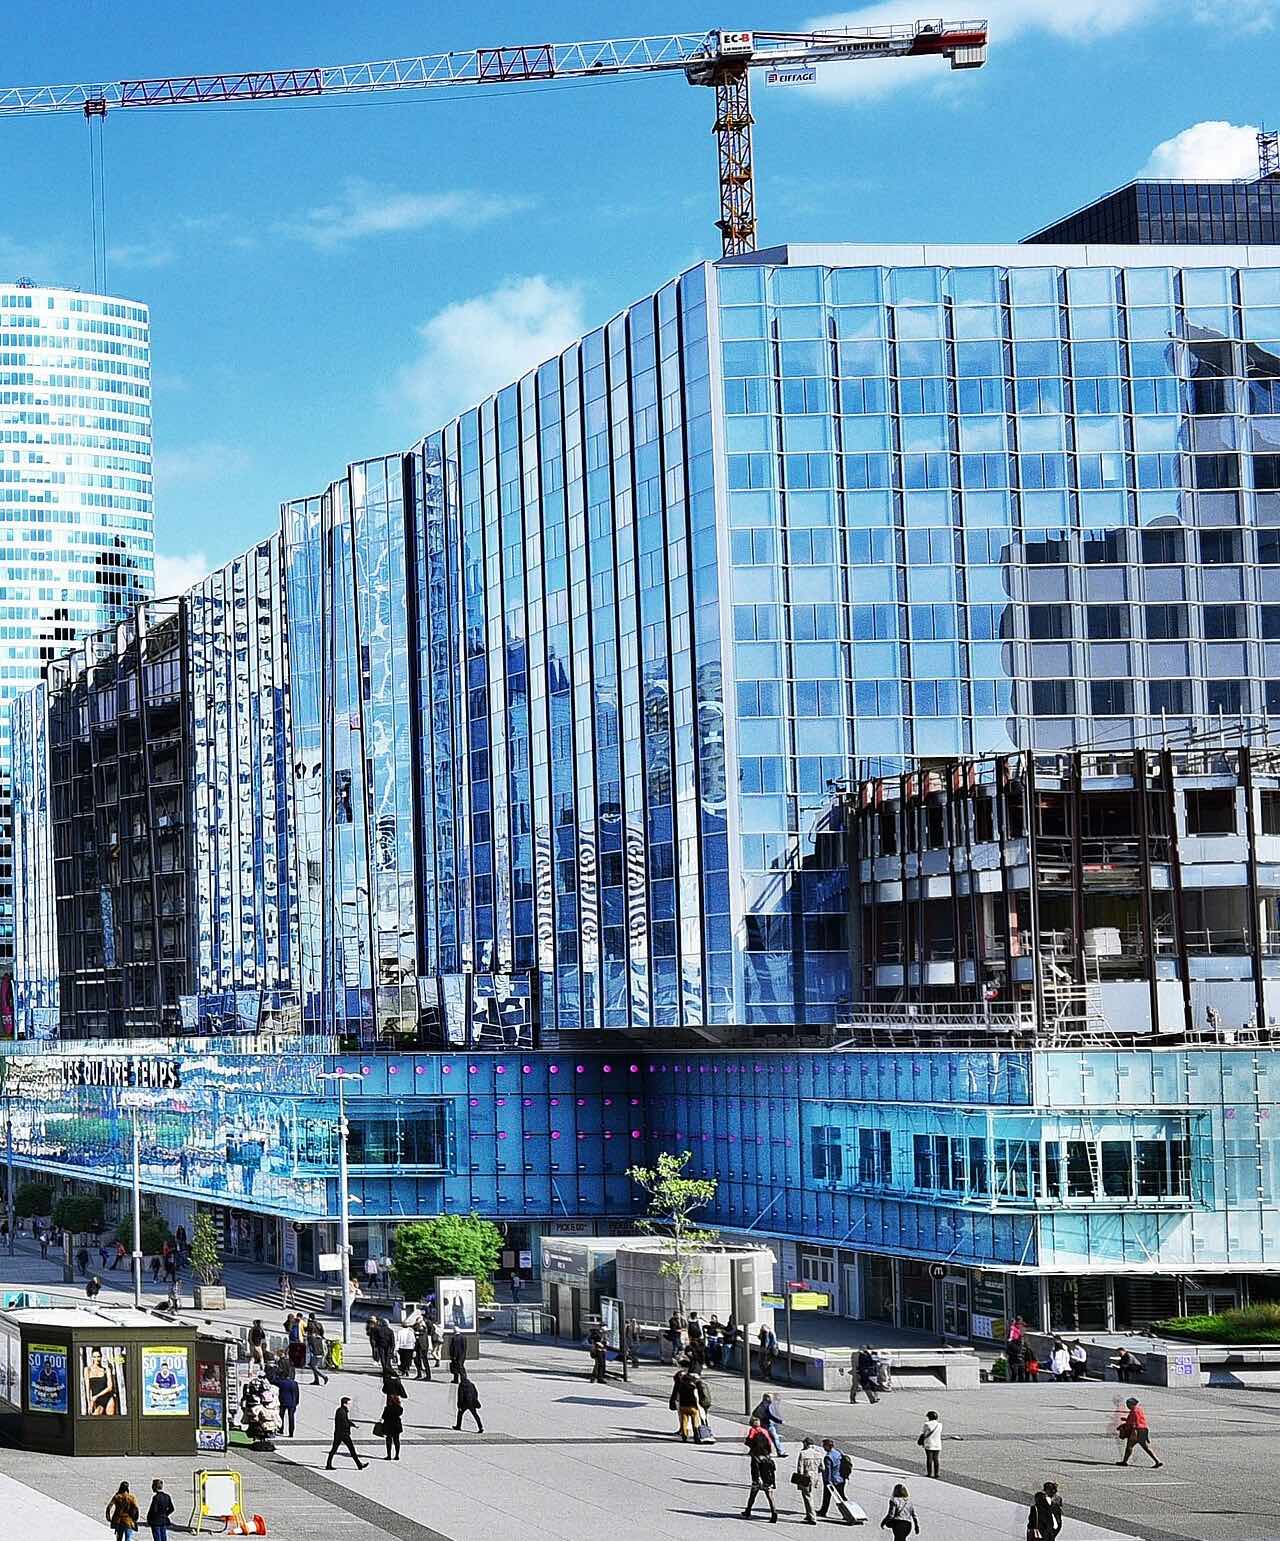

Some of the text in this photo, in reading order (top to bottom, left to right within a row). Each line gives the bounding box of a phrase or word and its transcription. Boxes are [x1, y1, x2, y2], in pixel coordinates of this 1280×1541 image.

[780, 73, 814, 83] EIFFAGE
[61, 1060, 177, 1089] LES QUATRE TEMPS
